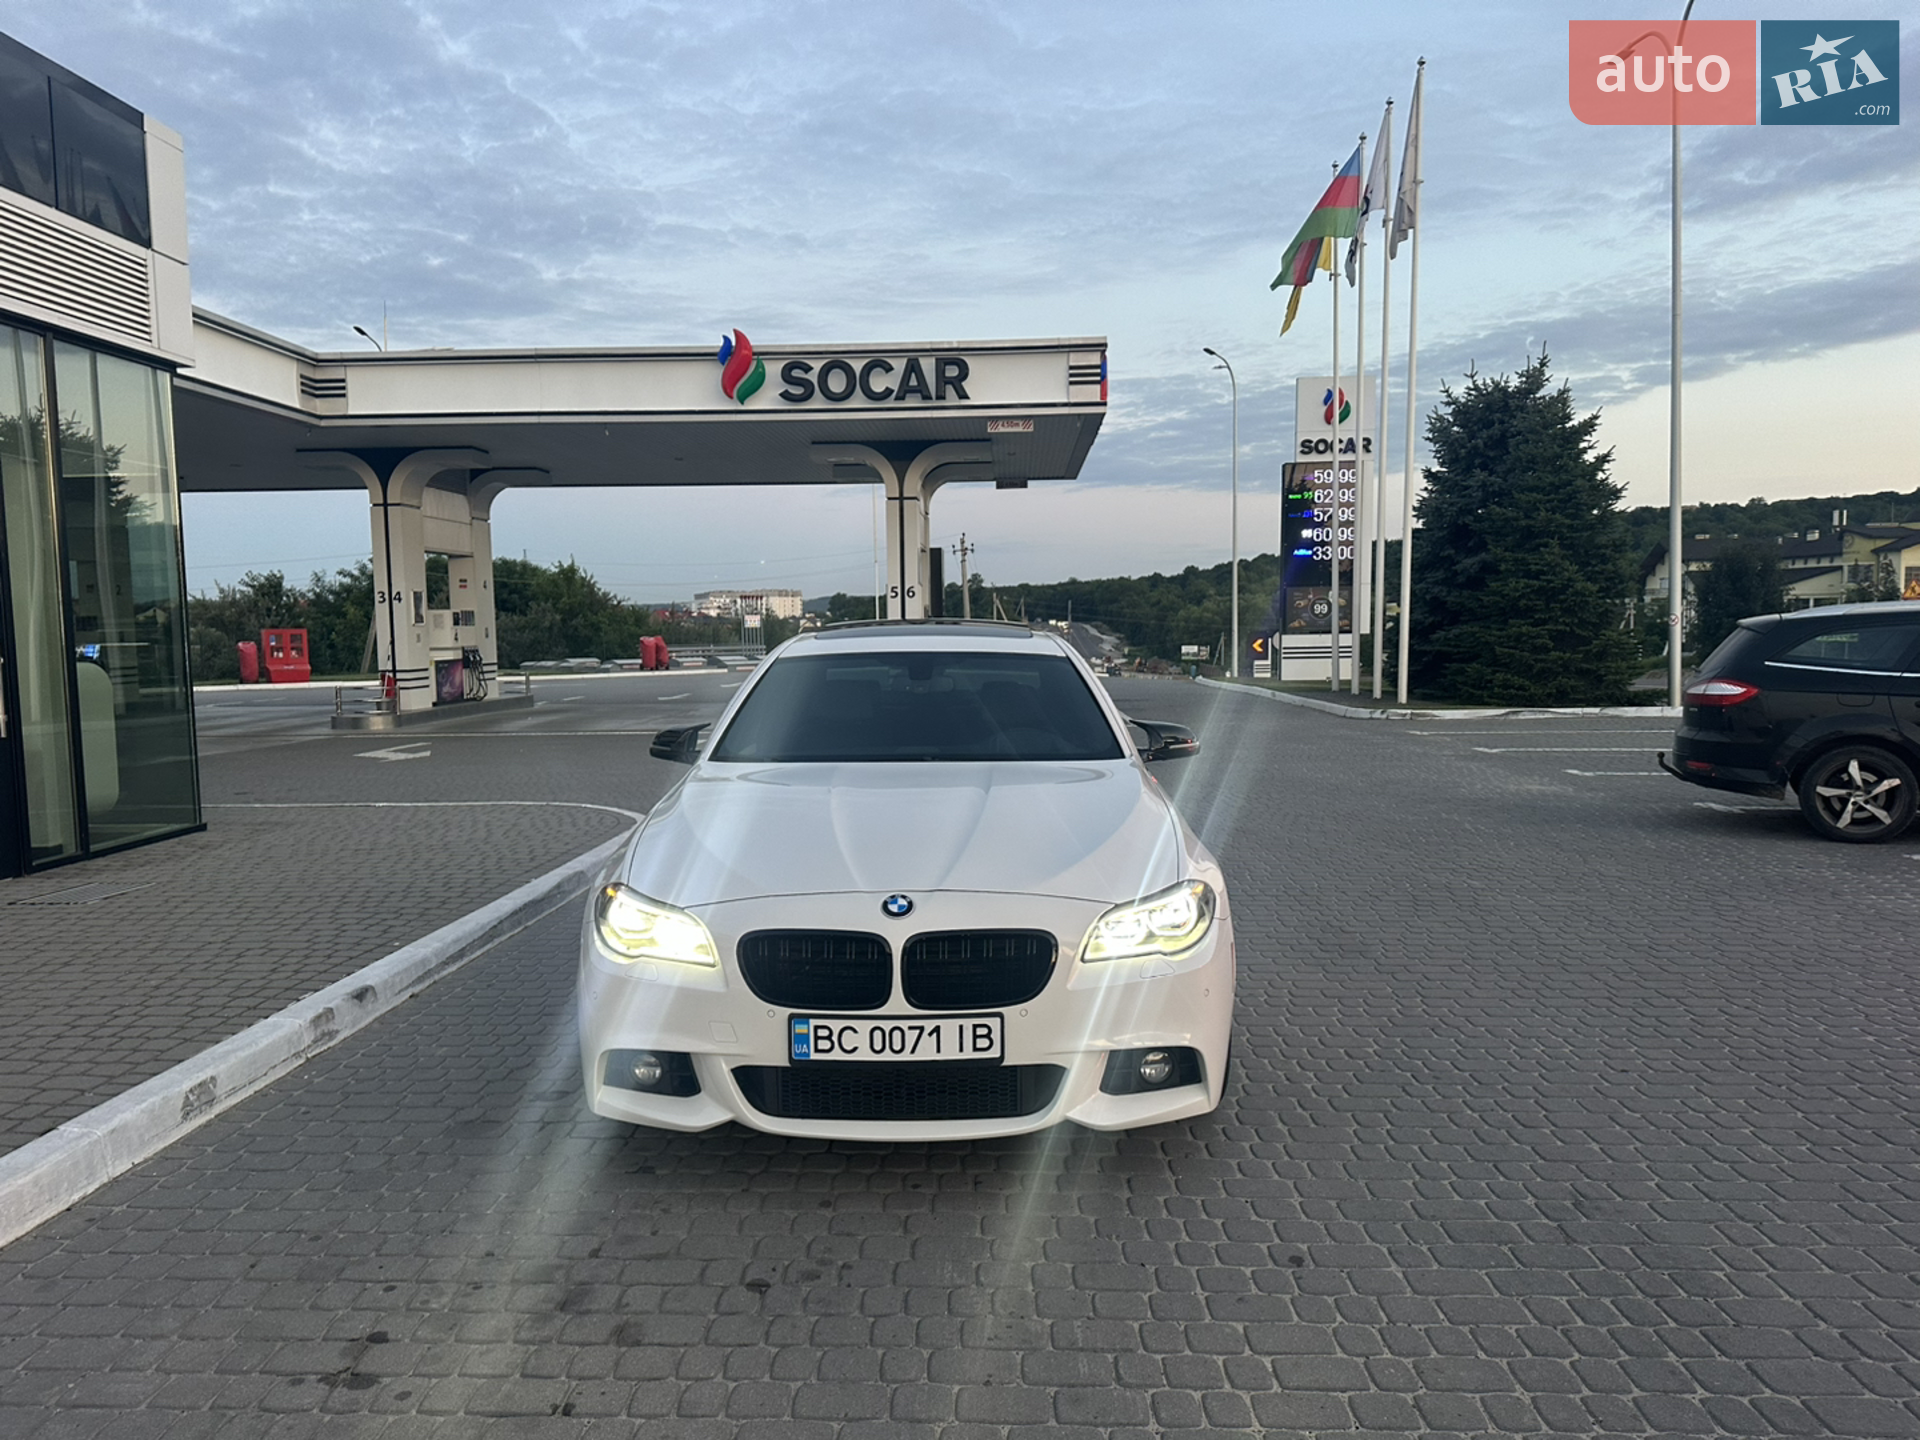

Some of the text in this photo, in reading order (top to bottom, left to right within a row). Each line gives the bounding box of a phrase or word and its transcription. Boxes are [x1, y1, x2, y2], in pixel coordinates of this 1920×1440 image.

[778, 356, 971, 404] SOCAR
[377, 591, 386, 604] 3
[393, 591, 403, 604] 4
[890, 586, 899, 599] 5
[906, 586, 916, 599] 6
[813, 1023, 994, 1055] BC 0071 IB
[794, 1044, 809, 1054] UA
